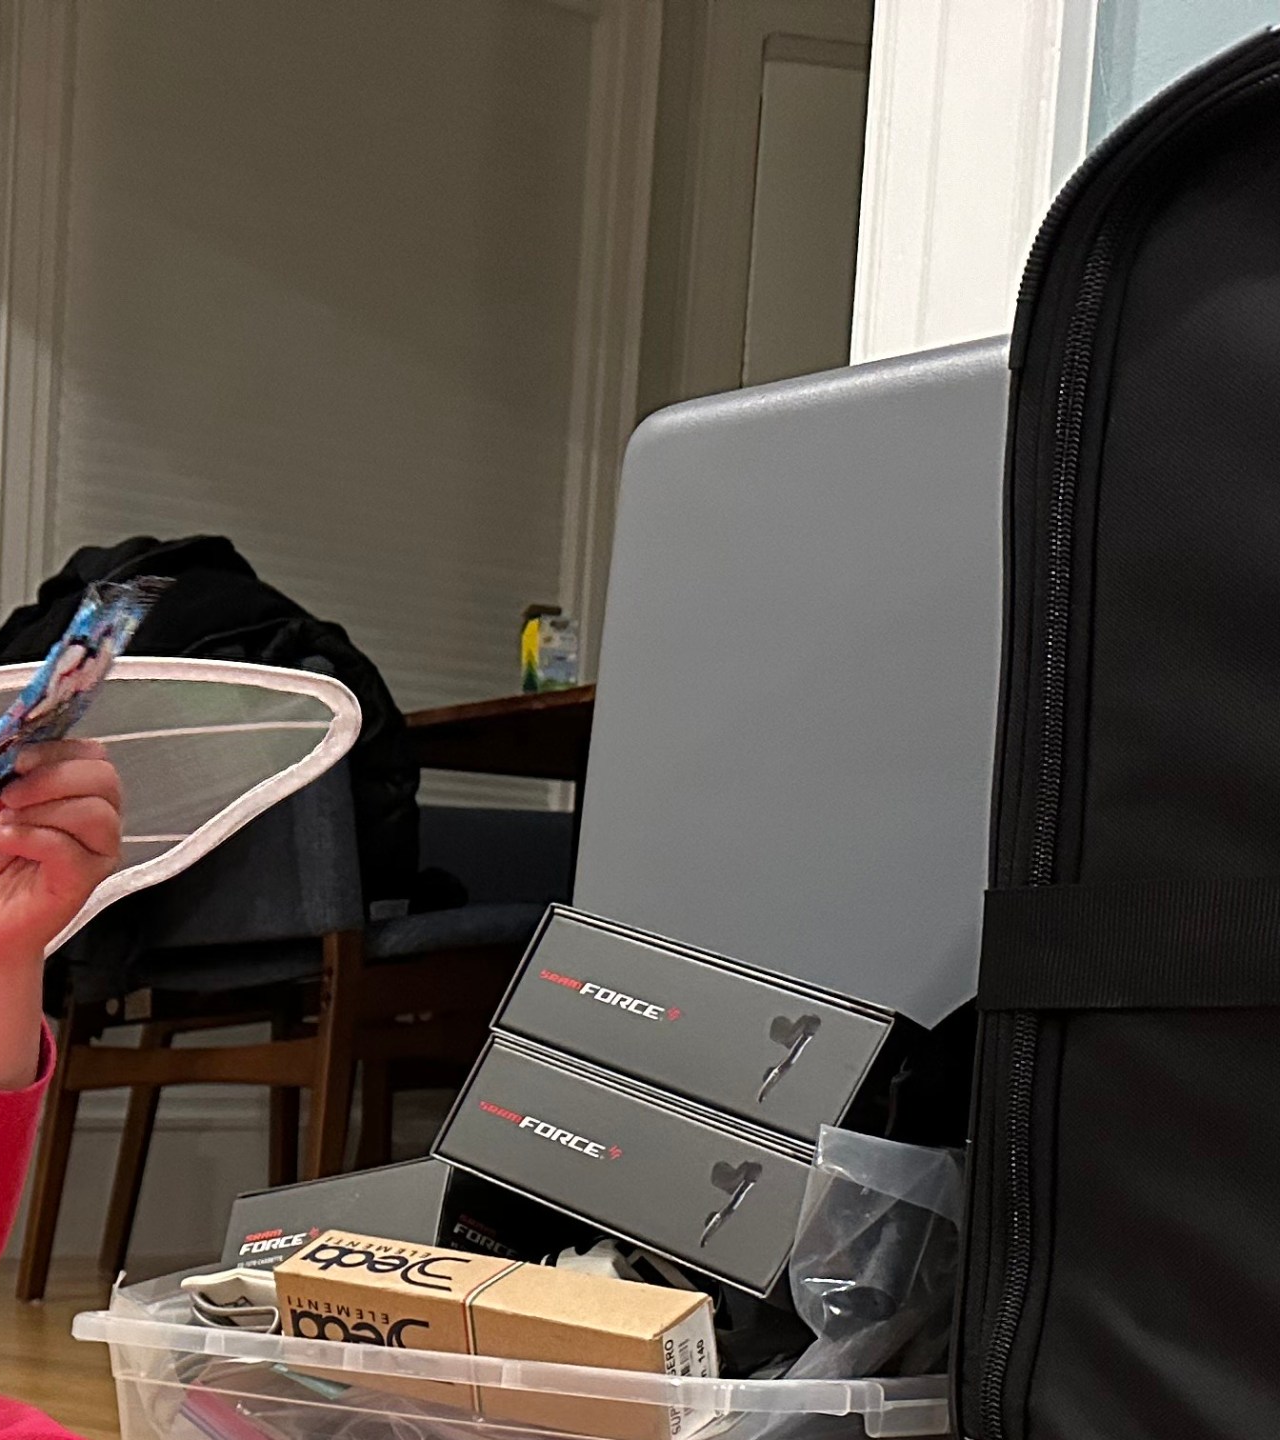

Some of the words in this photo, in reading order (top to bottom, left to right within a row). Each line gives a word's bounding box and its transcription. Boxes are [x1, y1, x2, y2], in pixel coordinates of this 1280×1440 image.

[579, 982, 665, 1021] FORCE
[518, 1115, 606, 1159] FORCE
[239, 1231, 308, 1256] FORCE
[324, 1236, 434, 1258] ELEMENTI
[287, 1294, 390, 1325] ELEMENTI
